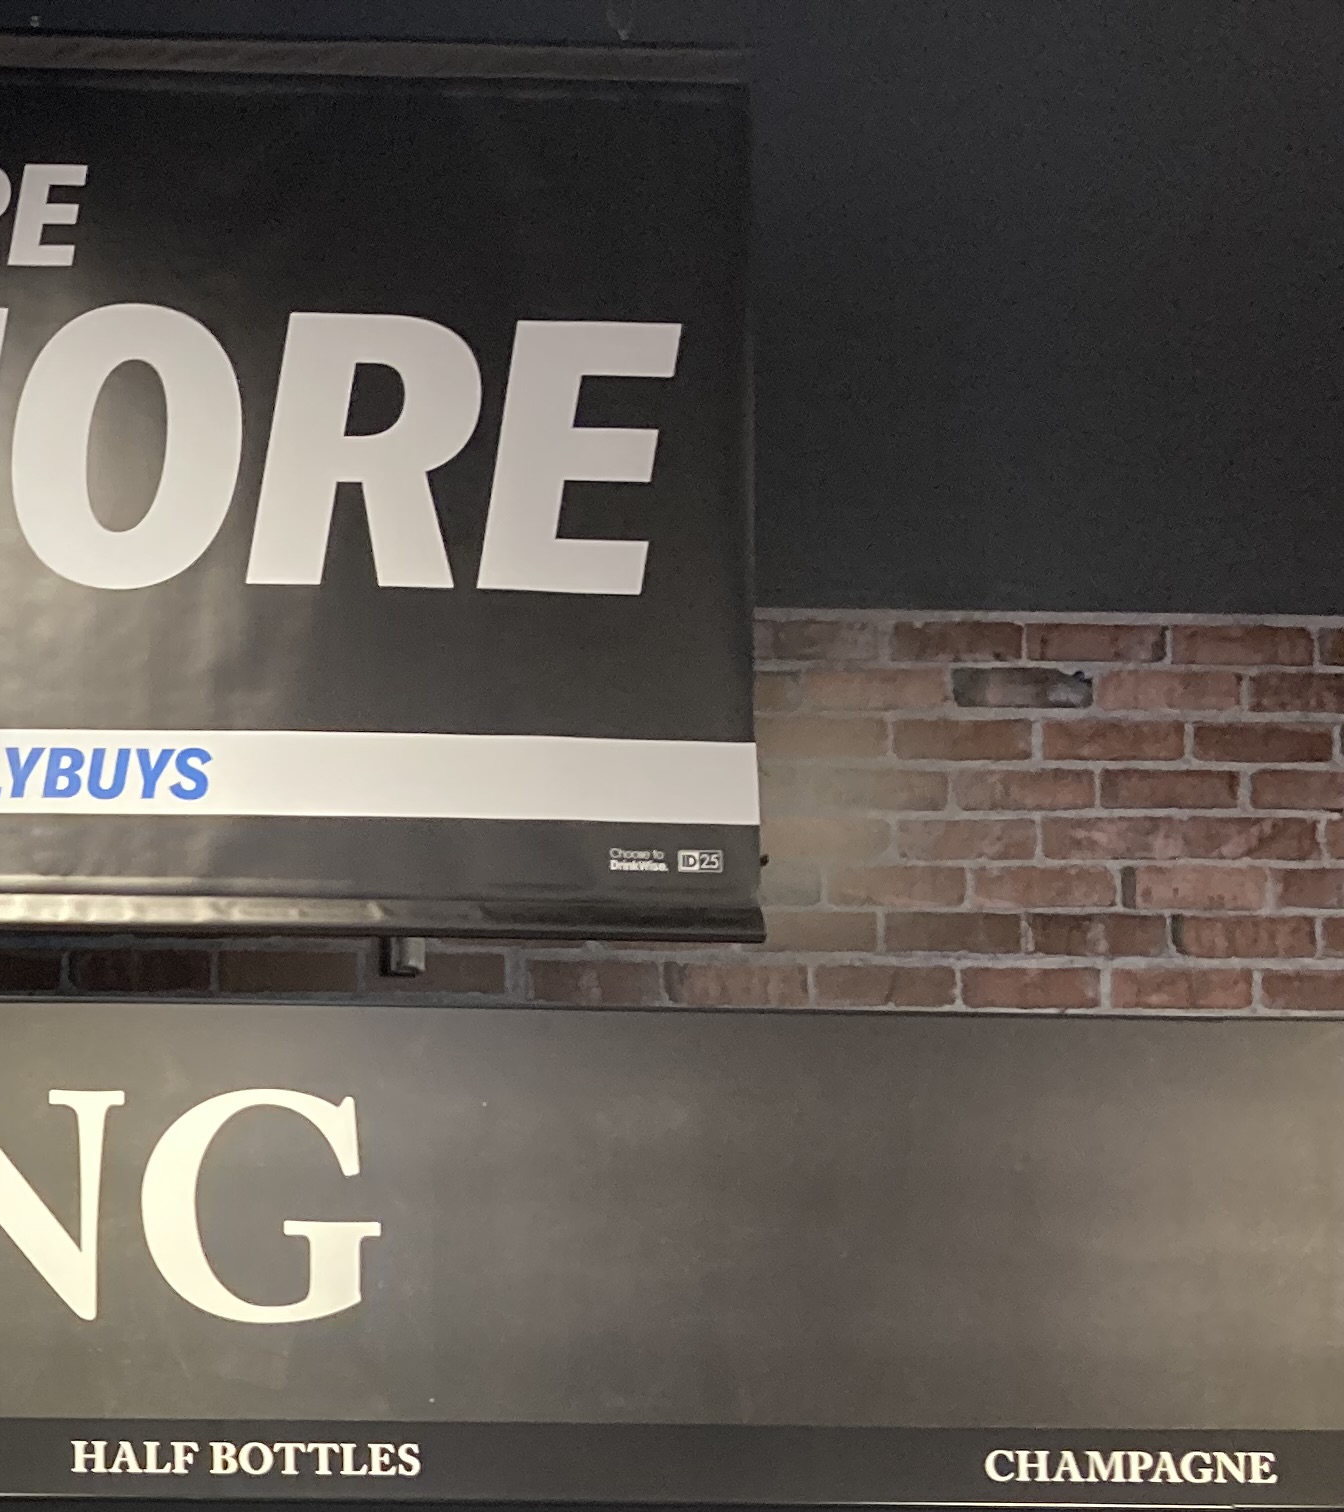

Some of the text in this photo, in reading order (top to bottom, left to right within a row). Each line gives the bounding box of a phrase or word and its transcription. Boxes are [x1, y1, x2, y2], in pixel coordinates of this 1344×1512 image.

[652, 849, 665, 860] to
[70, 1440, 421, 1477] HALF BOTTLES
[984, 1449, 1279, 1484] CHAMPAGNE
